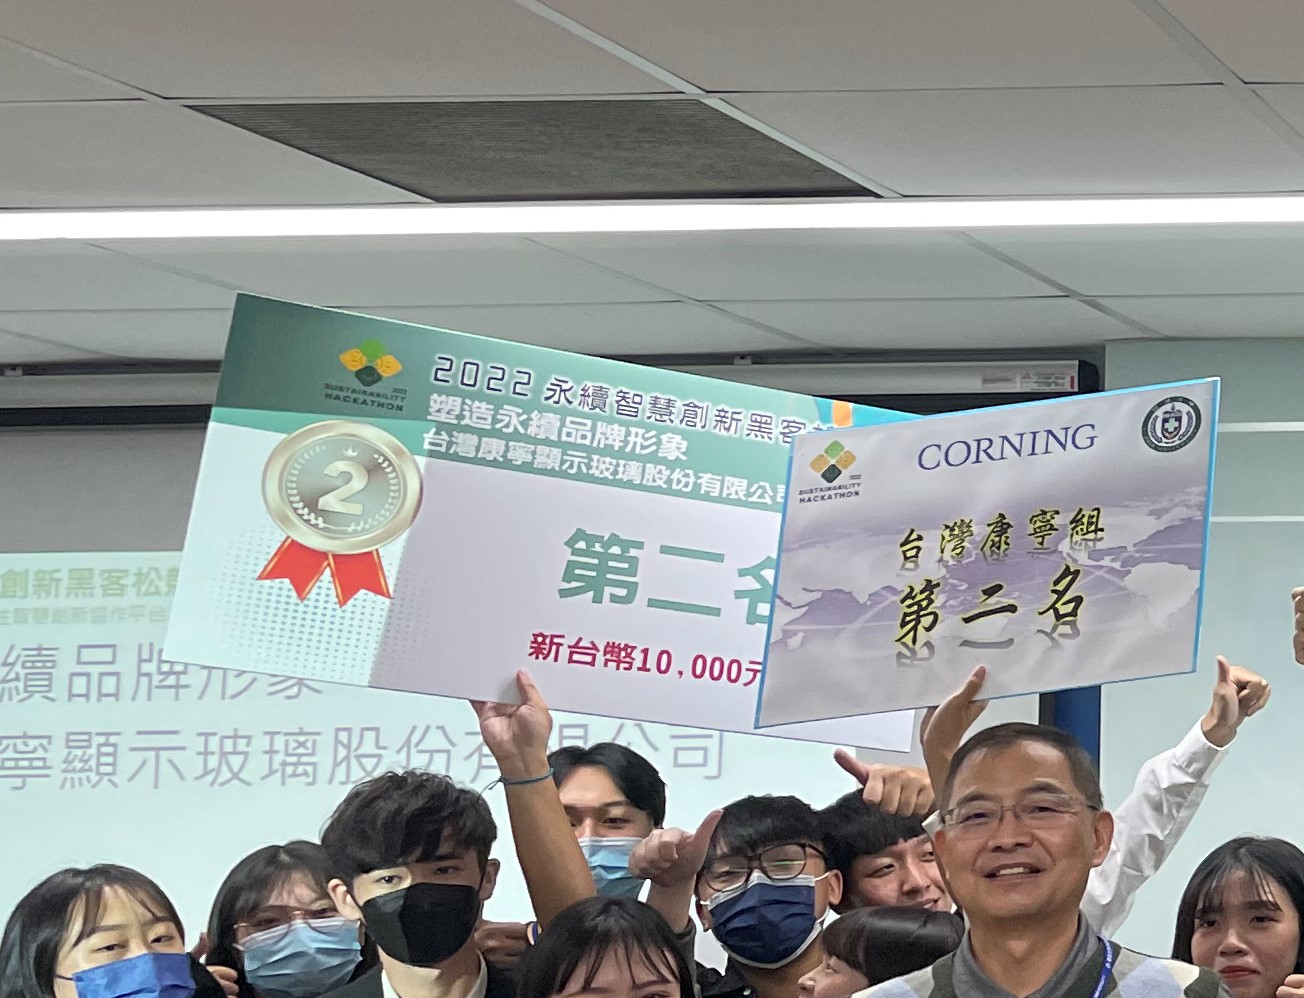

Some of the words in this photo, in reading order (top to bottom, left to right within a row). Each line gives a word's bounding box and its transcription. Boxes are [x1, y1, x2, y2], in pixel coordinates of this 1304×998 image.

[427, 393, 689, 461] 塑造永續品牌形象
[433, 355, 532, 398] 2022
[543, 376, 833, 445] 永續智慧創新黑客
[917, 423, 1098, 470] CORNING
[318, 460, 369, 515] 2
[899, 506, 1105, 562] 台灣康寧組
[894, 563, 1084, 646] 第二名
